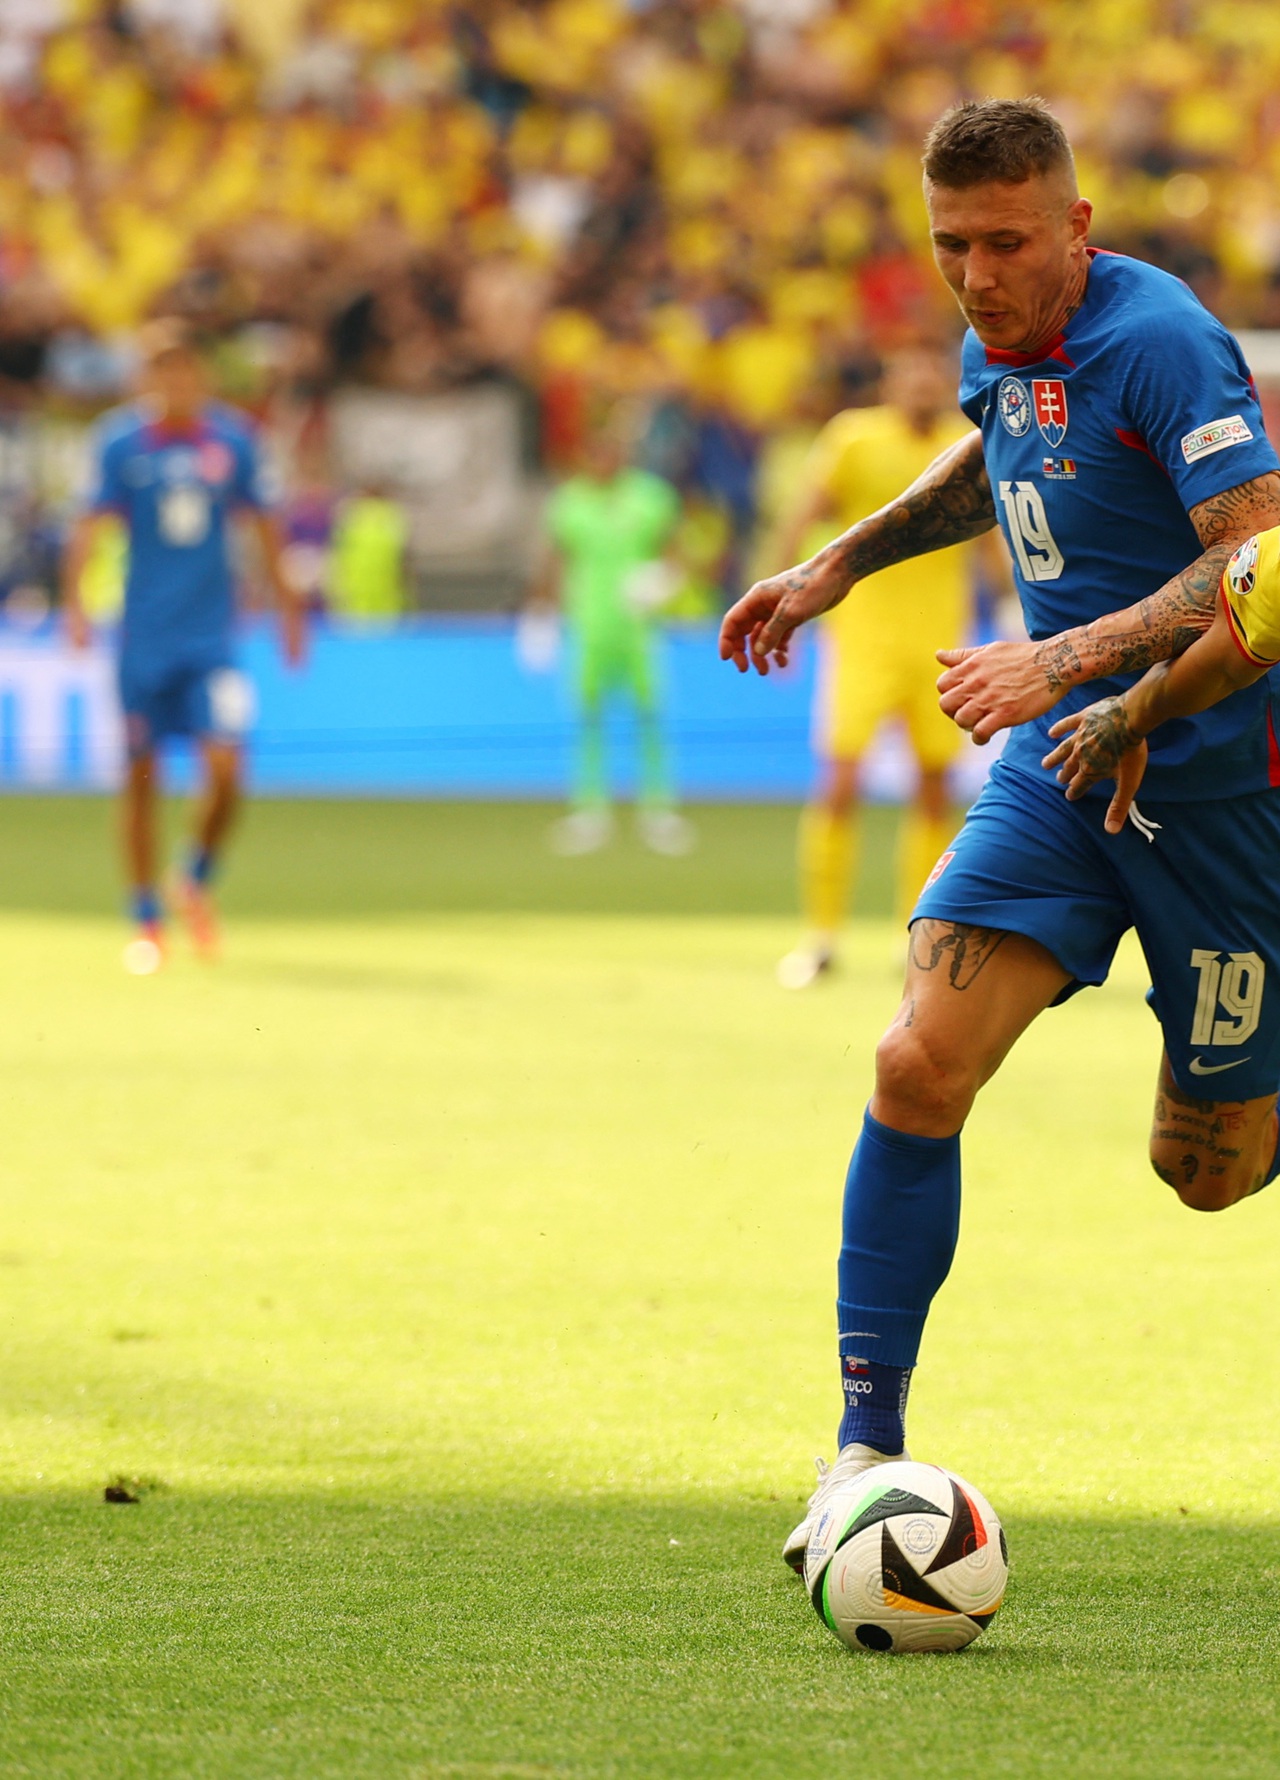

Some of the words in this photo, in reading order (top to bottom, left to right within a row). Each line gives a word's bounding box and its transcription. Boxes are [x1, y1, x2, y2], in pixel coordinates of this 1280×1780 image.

[1183, 423, 1247, 454] FOUNDATION
[998, 481, 1065, 582] 19
[1190, 949, 1266, 1046] 19
[843, 1377, 873, 1394] KUCO
[848, 1395, 859, 1407] 19
